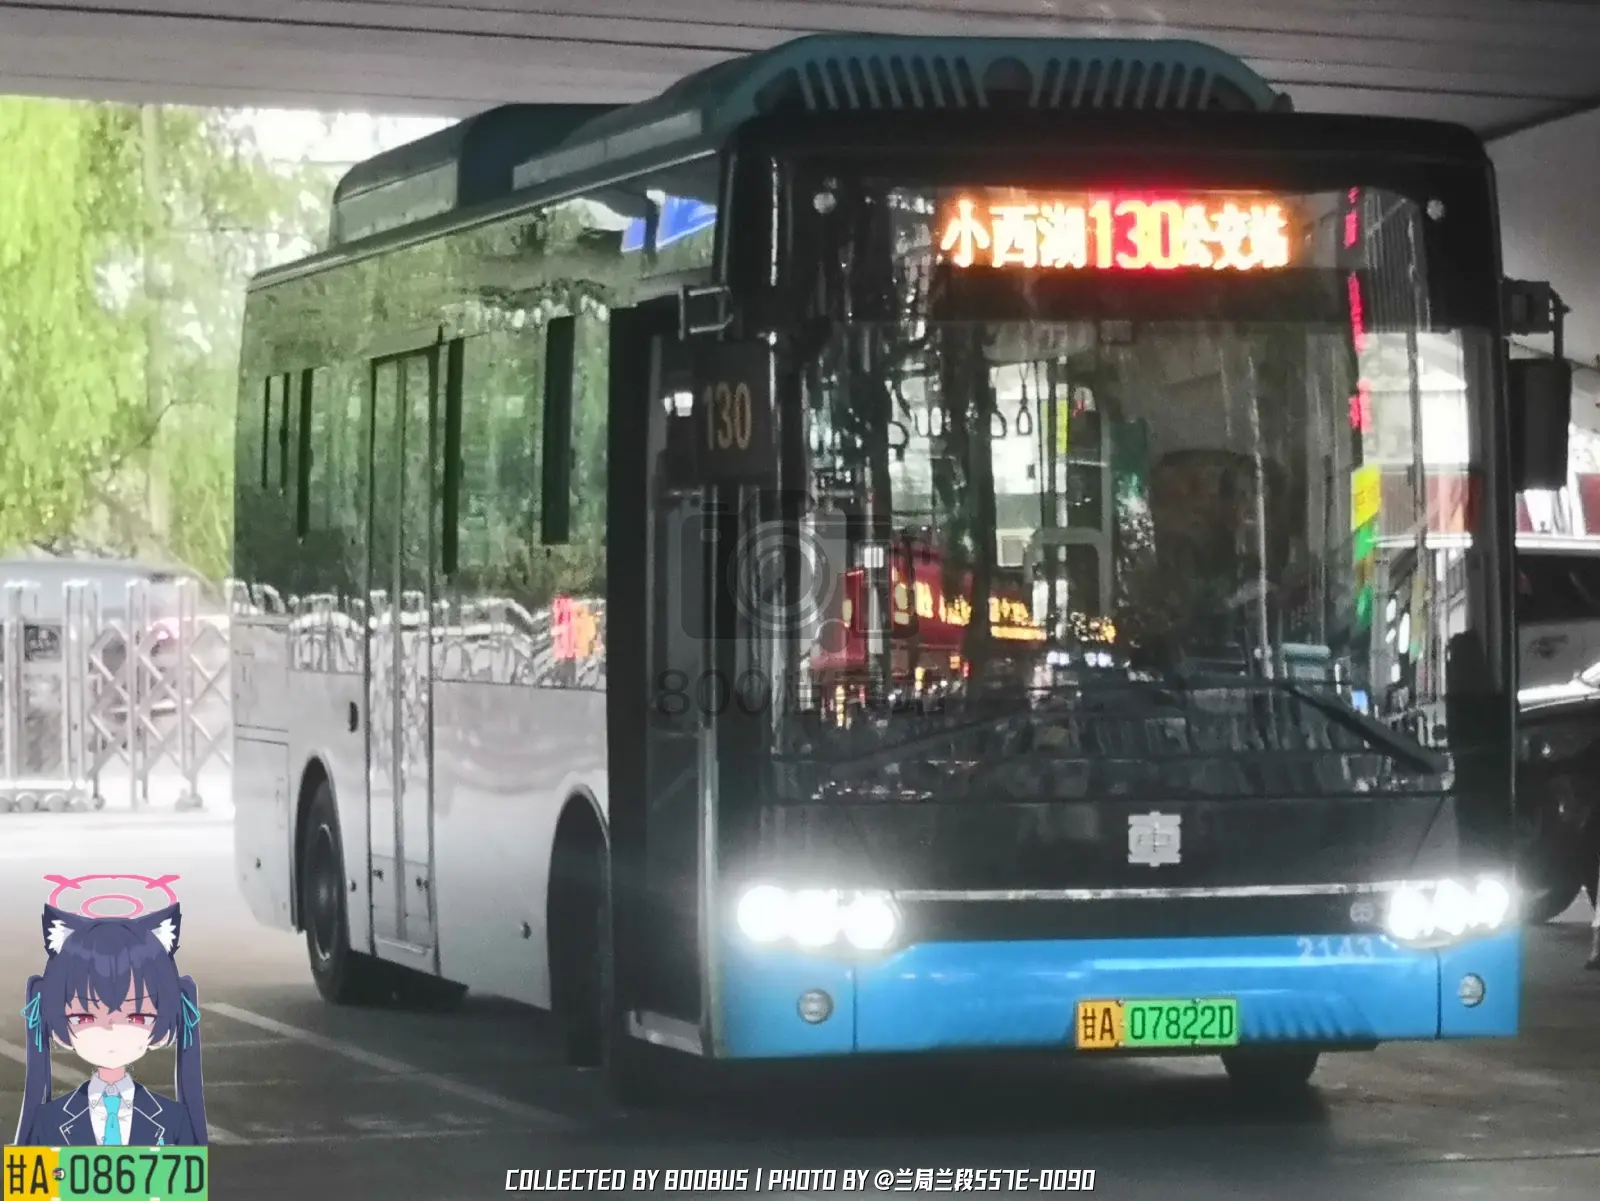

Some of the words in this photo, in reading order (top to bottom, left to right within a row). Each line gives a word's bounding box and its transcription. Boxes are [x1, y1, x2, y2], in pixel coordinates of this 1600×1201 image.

[703, 382, 752, 450] 130
[1081, 1007, 1116, 1041] 甘A
[1130, 1005, 1234, 1040] 07822D
